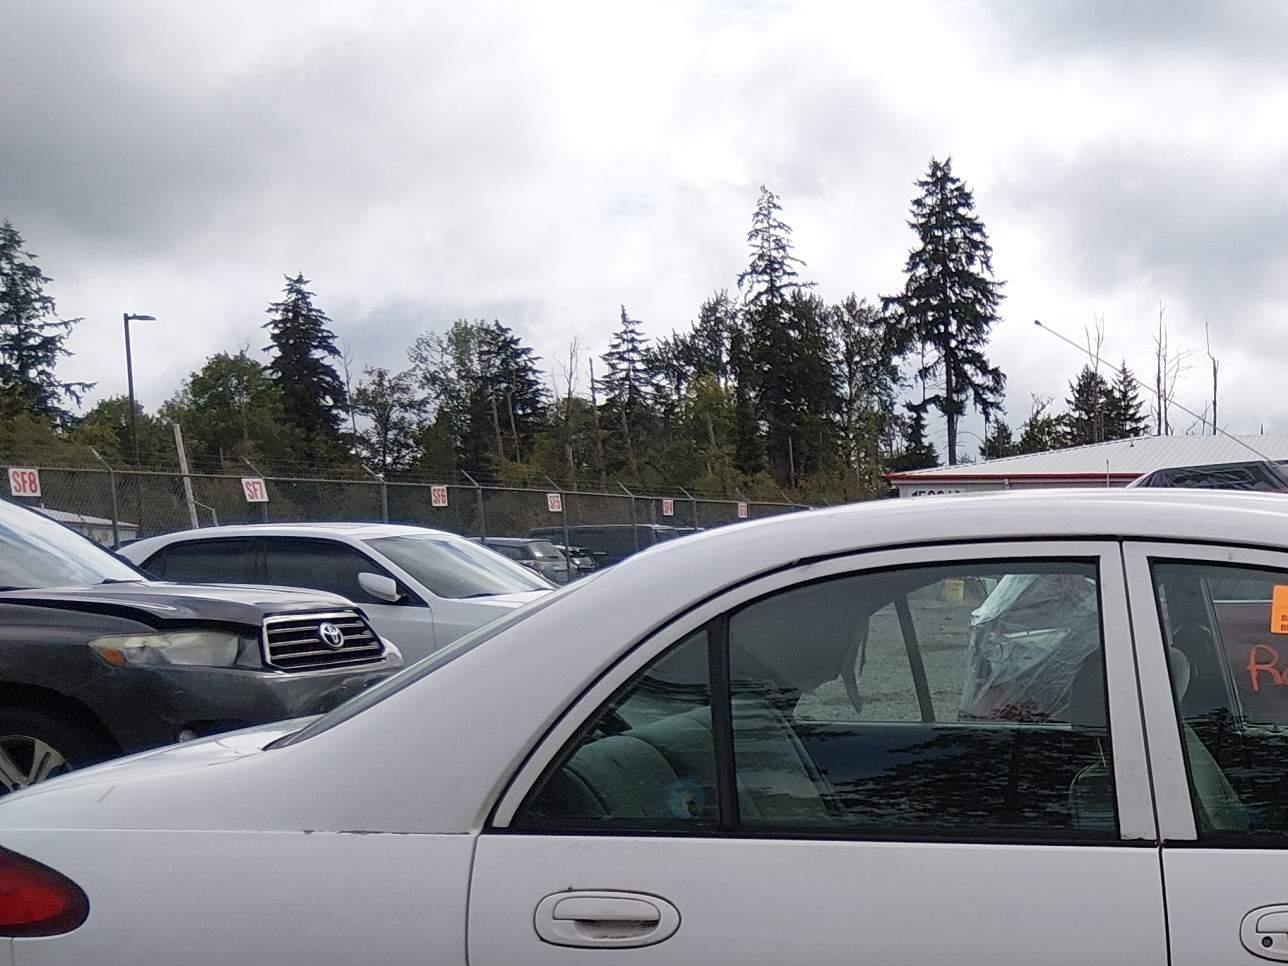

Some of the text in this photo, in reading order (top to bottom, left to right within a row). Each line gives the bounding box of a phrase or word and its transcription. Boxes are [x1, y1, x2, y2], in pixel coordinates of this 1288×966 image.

[12, 471, 37, 493] SF8
[246, 481, 265, 500] SF7
[433, 488, 446, 504] SF6
